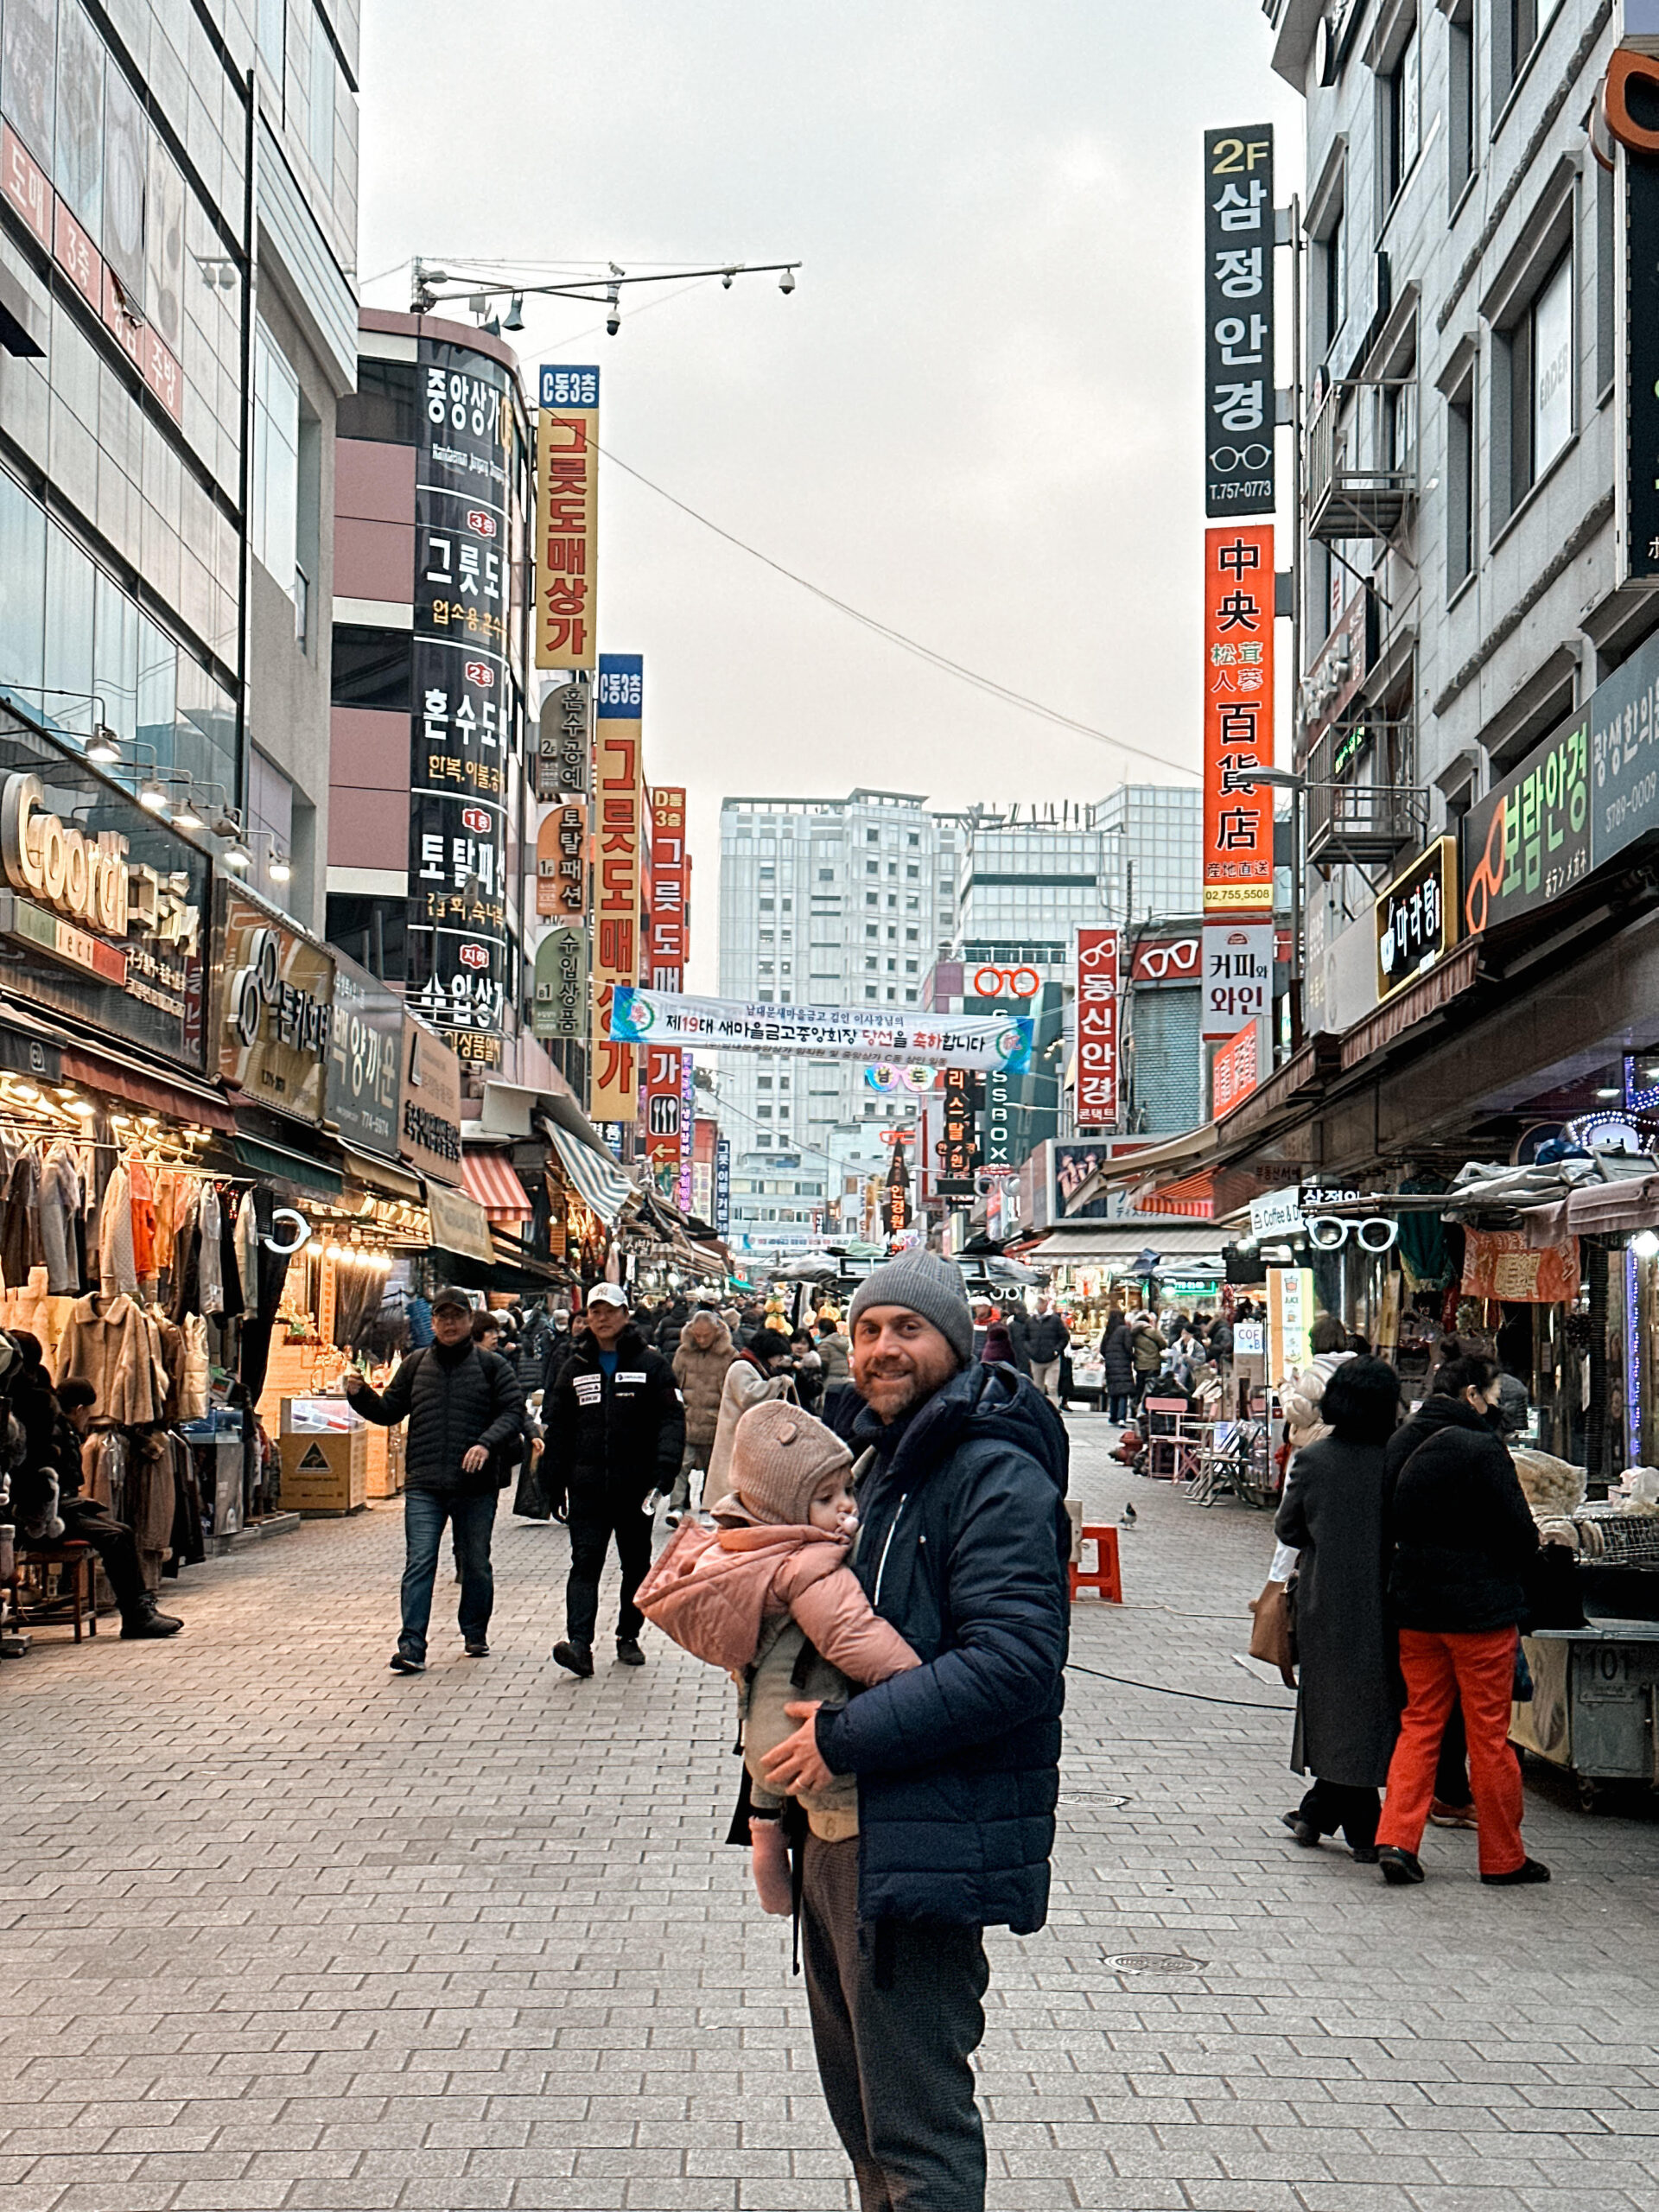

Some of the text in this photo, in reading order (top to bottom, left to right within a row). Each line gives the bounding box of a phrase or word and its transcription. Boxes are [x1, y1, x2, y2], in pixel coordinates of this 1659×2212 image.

[1212, 138, 1269, 175] 2F
[1212, 179, 1268, 432] 삼정안경
[427, 367, 499, 445] 중앙상가
[543, 372, 596, 404] C동3층
[1210, 479, 1271, 501] T.757-0773
[544, 417, 588, 655] 그릇도매상가
[1217, 537, 1262, 633] 中央
[1211, 641, 1263, 666] 松茸
[601, 672, 642, 705] C동3층
[562, 687, 585, 790] 혼수공예
[655, 790, 683, 808] D동
[1216, 701, 1262, 851] 百貨店
[655, 810, 682, 827] 3층
[1503, 721, 1588, 897] 보람안경
[419, 834, 505, 899] 토탈패션
[560, 809, 583, 908] 토탈패션
[1396, 874, 1436, 957] 마라탕
[559, 932, 580, 1032] 수입상품
[652, 837, 682, 1084] 그릇도매가
[1210, 953, 1268, 979] 커피와
[747, 1005, 827, 1021] 남대문새마을금고
[854, 1014, 904, 1027] 이사장님의
[1210, 985, 1263, 1015] 와인
[666, 1014, 985, 1052] 제19대 새마을금고중앙회장 당선을 축하합니다
[1079, 973, 1116, 1105] 동신안경
[1078, 1108, 1116, 1121] 콘택트
[1263, 1207, 1286, 1226] Coffee
